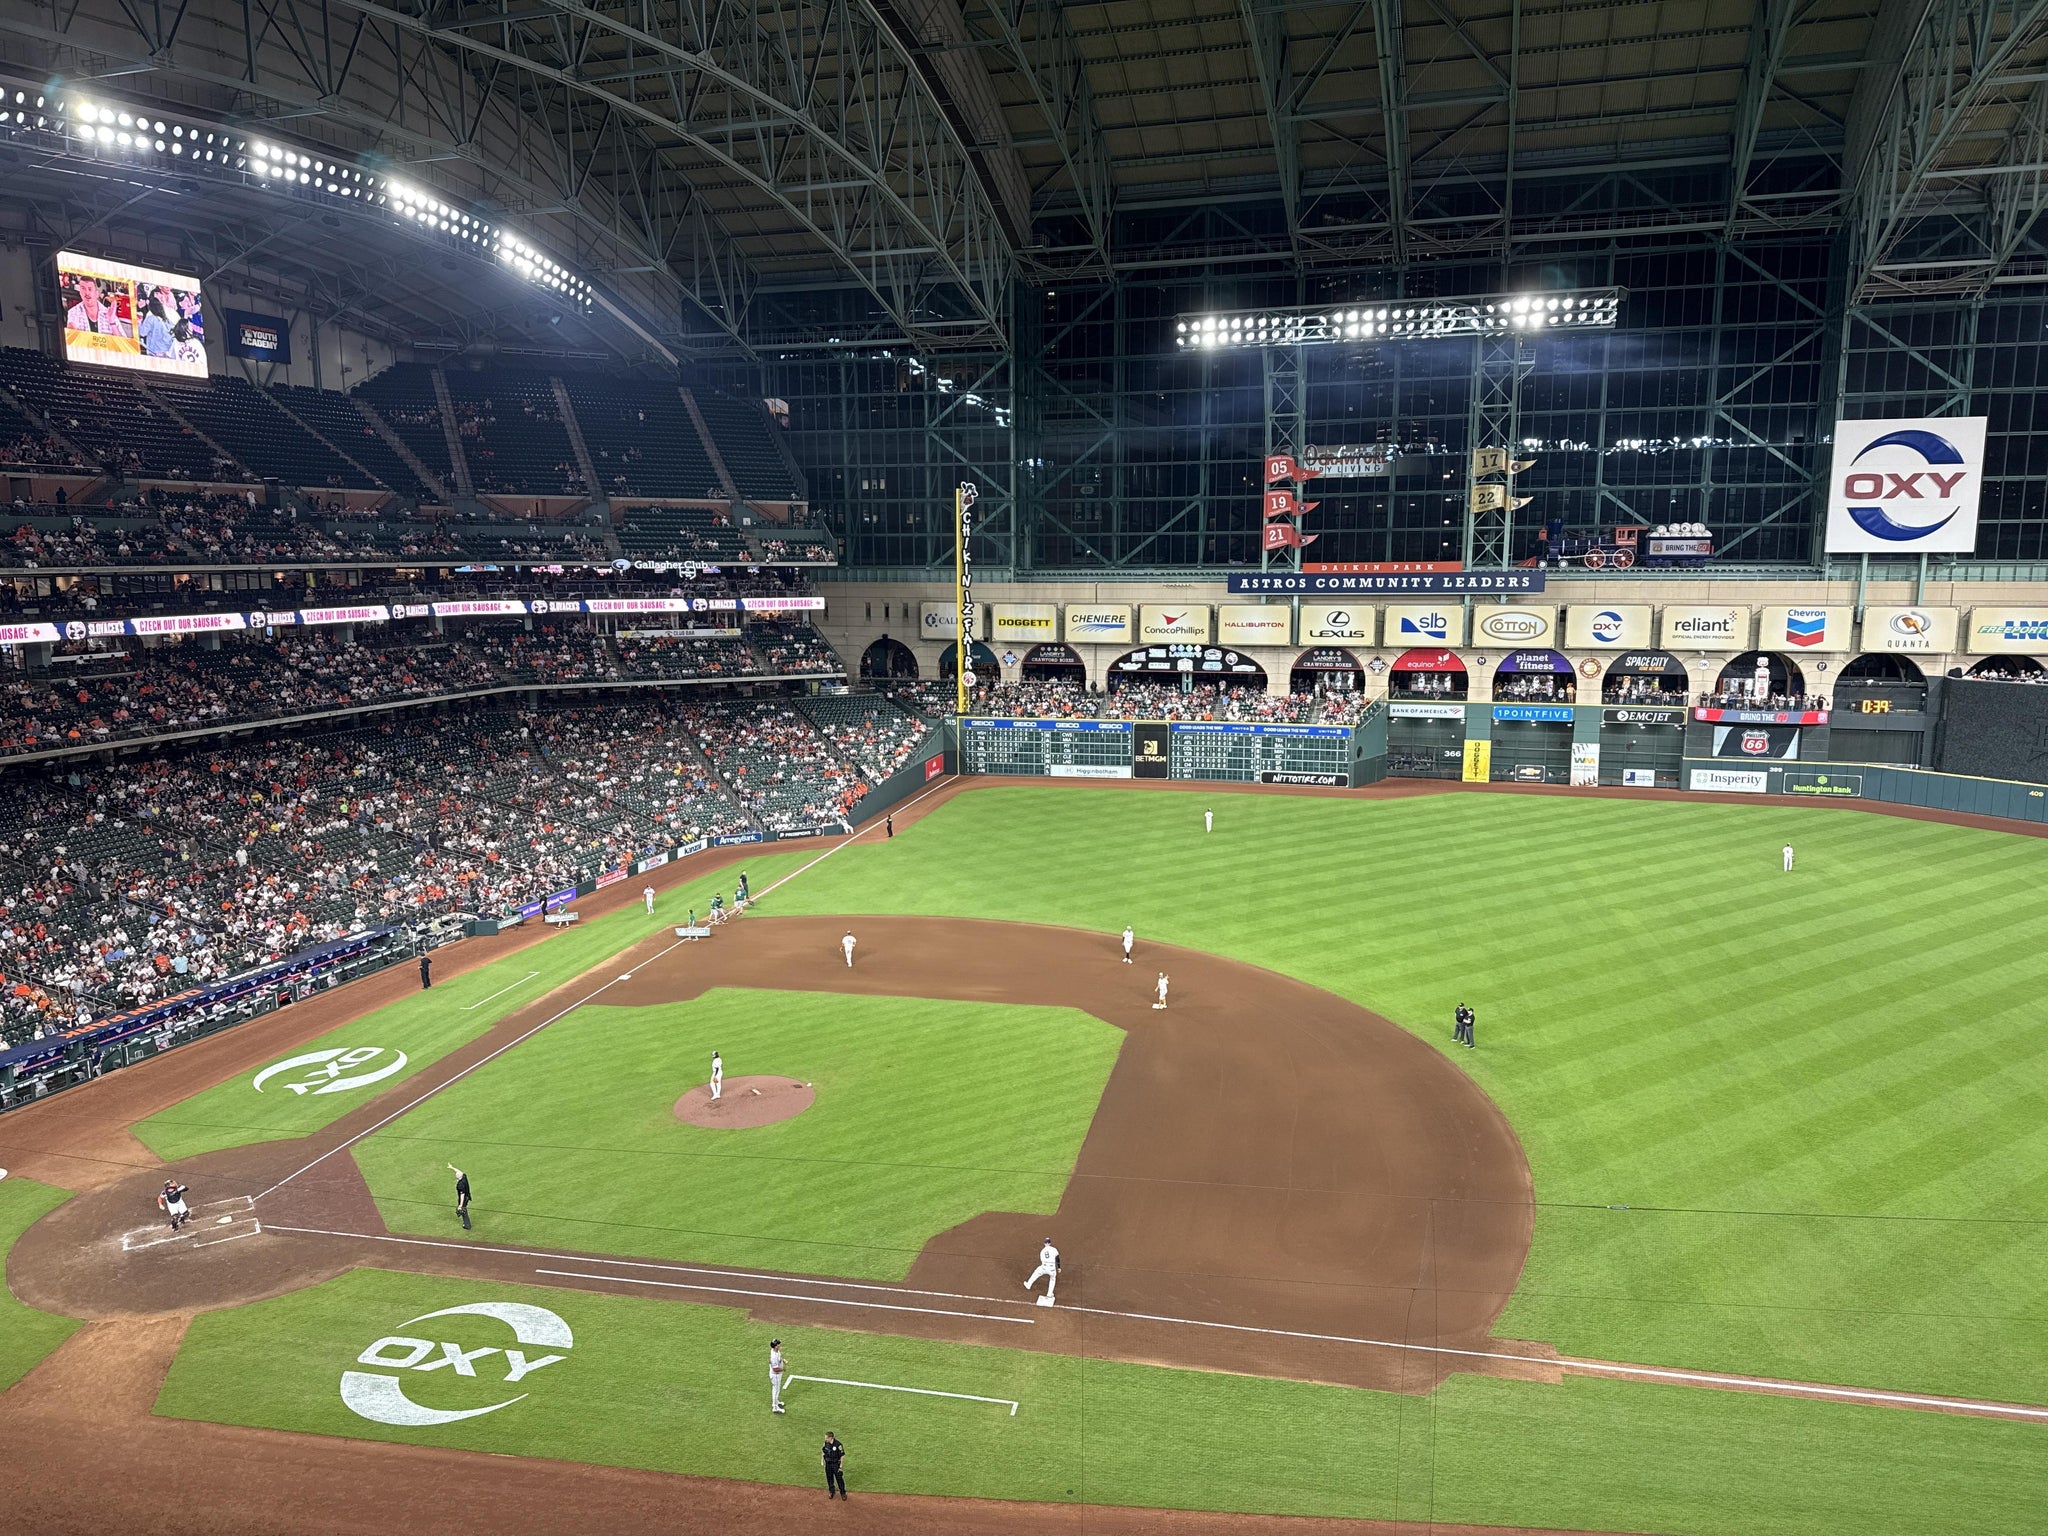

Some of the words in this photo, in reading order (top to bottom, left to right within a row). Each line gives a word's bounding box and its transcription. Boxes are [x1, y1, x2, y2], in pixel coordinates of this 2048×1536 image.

[252, 330, 278, 342] YOUTH
[241, 337, 278, 350] ACADEMY
[1481, 454, 1498, 468] 17
[1271, 460, 1287, 475] 05
[1337, 465, 1380, 473] LIVING
[1844, 472, 1966, 499] OXY
[1271, 496, 1287, 509] 19
[1478, 492, 1495, 505] 22
[1269, 529, 1284, 541] 21
[634, 560, 682, 570] Gallagher
[684, 560, 708, 569] Club
[1240, 578, 1306, 588] ASTROS
[1316, 577, 1433, 588] COMMUNITY
[1443, 576, 1530, 587] LEADERS
[1071, 614, 1126, 623] CHENIERE
[1787, 609, 1826, 617] Chevron
[139, 620, 162, 632] CZECH
[163, 619, 176, 631] OUT
[178, 618, 191, 630] OUR
[193, 616, 222, 628] SAUSAGE
[998, 618, 1051, 627] DOGGETT
[1419, 612, 1447, 629] slb
[1490, 618, 1537, 634] COTTON
[1674, 617, 1730, 632] reliant
[1144, 625, 1205, 636] ConocoPhillips
[1593, 623, 1621, 631] OXY
[1979, 626, 2048, 634] FREEPORT
[1309, 630, 1365, 638] LEXUS
[961, 617, 973, 671] FAIR
[1887, 640, 1930, 648] QUANTA
[1516, 653, 1549, 664] planet
[1625, 656, 1651, 667] SPACE
[1651, 657, 1669, 666] CITY
[1407, 661, 1435, 669] equinor
[1519, 661, 1554, 671] fitness
[1498, 707, 1569, 719] 1POINTFIVE
[1629, 711, 1671, 722] EMCJET
[1740, 712, 1761, 721] BRING
[1762, 713, 1775, 721] THE
[1746, 740, 1763, 749] 66
[1135, 755, 1166, 763] BETMGM
[1272, 774, 1337, 786] NITTOTIRE.COM
[1710, 773, 1761, 786] Insperity
[1793, 785, 1831, 794] Huntington
[1833, 786, 1851, 794] Bank
[284, 1047, 385, 1096] OXY
[357, 1336, 568, 1383] OXY
